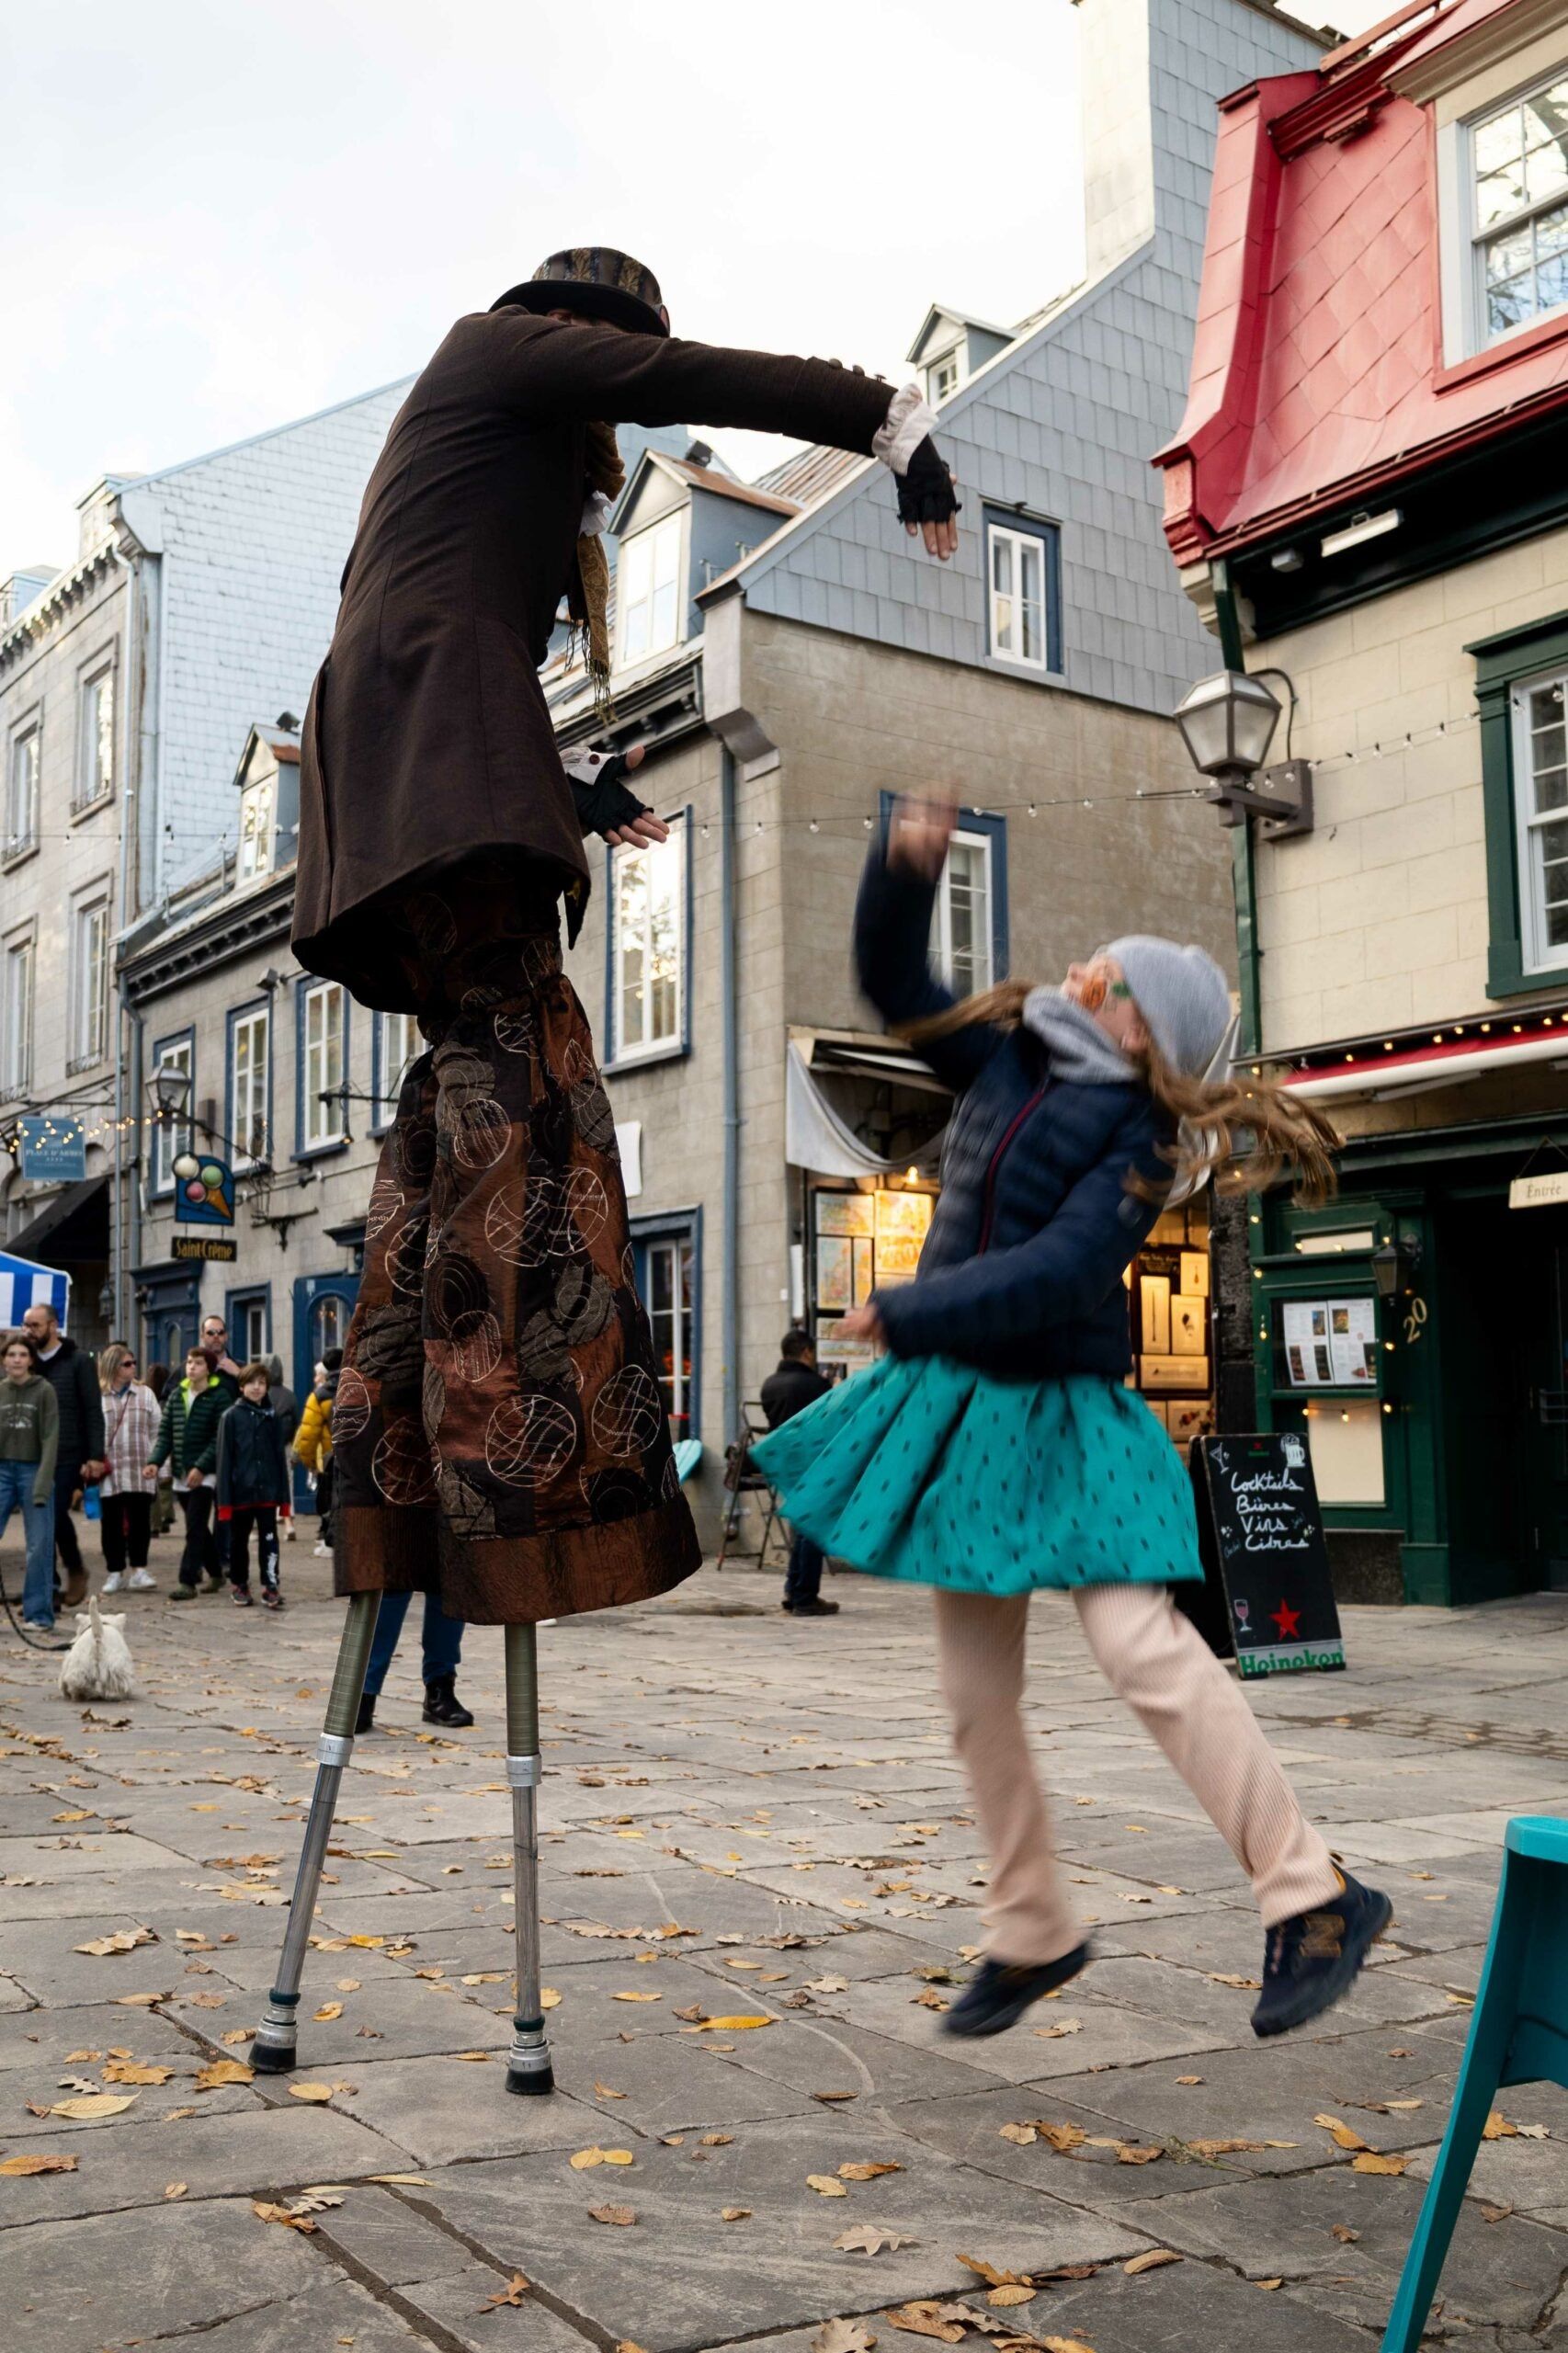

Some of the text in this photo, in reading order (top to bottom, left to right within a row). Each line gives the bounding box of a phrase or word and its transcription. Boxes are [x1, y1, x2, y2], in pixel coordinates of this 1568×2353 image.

[1528, 1182, 1562, 1199] Entrée
[1403, 1297, 1427, 1343] 20
[1231, 1468, 1304, 1492] Cocktails
[1236, 1495, 1295, 1515] Bières
[1241, 1516, 1289, 1534] Vins
[1245, 1534, 1310, 1551] Cidres
[1239, 1649, 1342, 1673] Heineken
